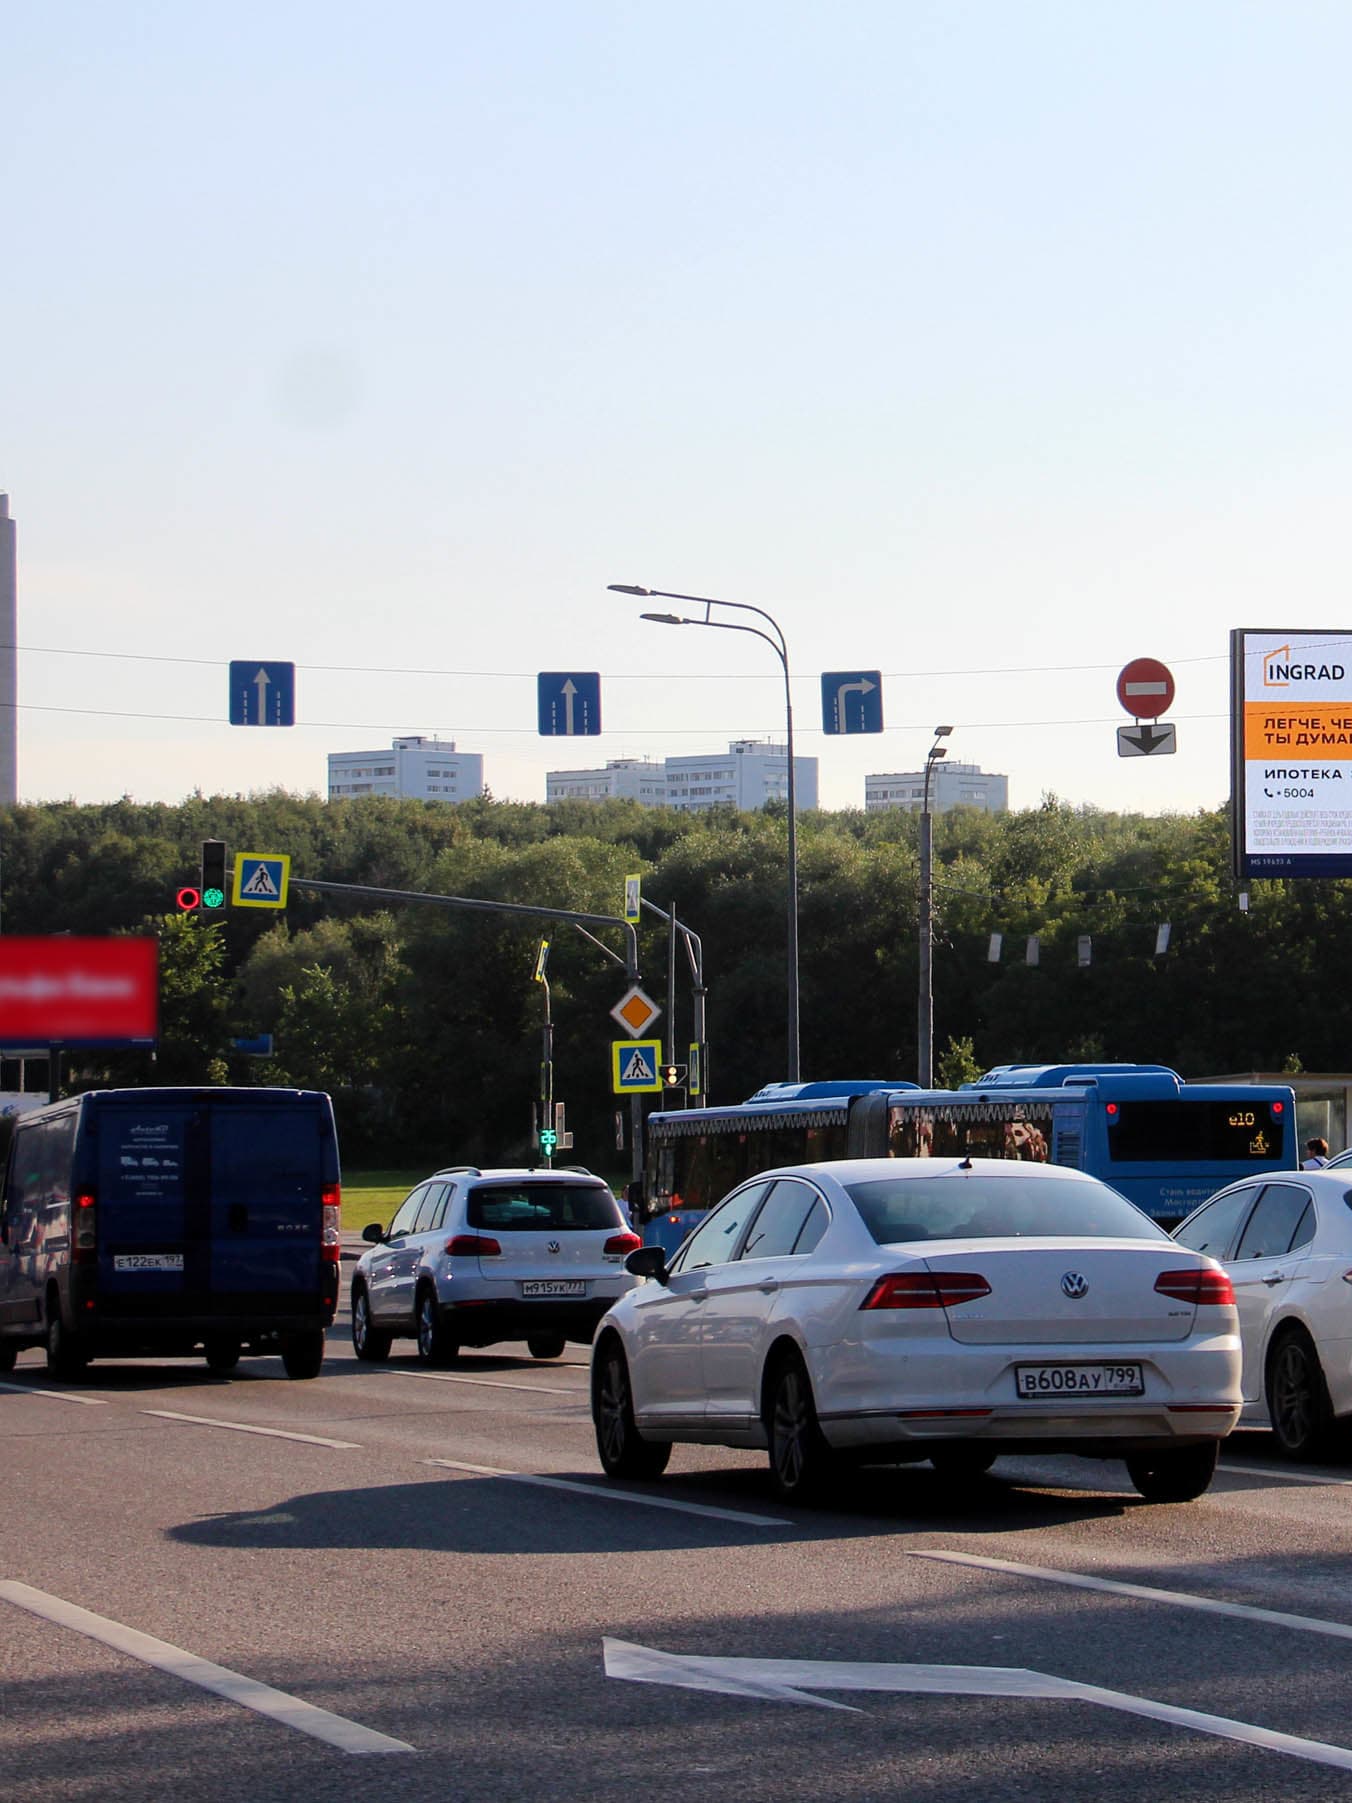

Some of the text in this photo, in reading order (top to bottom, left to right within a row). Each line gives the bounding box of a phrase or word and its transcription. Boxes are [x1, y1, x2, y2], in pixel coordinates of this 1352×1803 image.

[1269, 664, 1345, 680] INGRAD
[1264, 718, 1326, 730] ЛЕГЧЕ,
[1264, 733, 1291, 744] ТЫ
[1264, 769, 1343, 779] ИПОТЕКА
[1228, 1112, 1255, 1126] e10
[540, 1129, 557, 1144] 26
